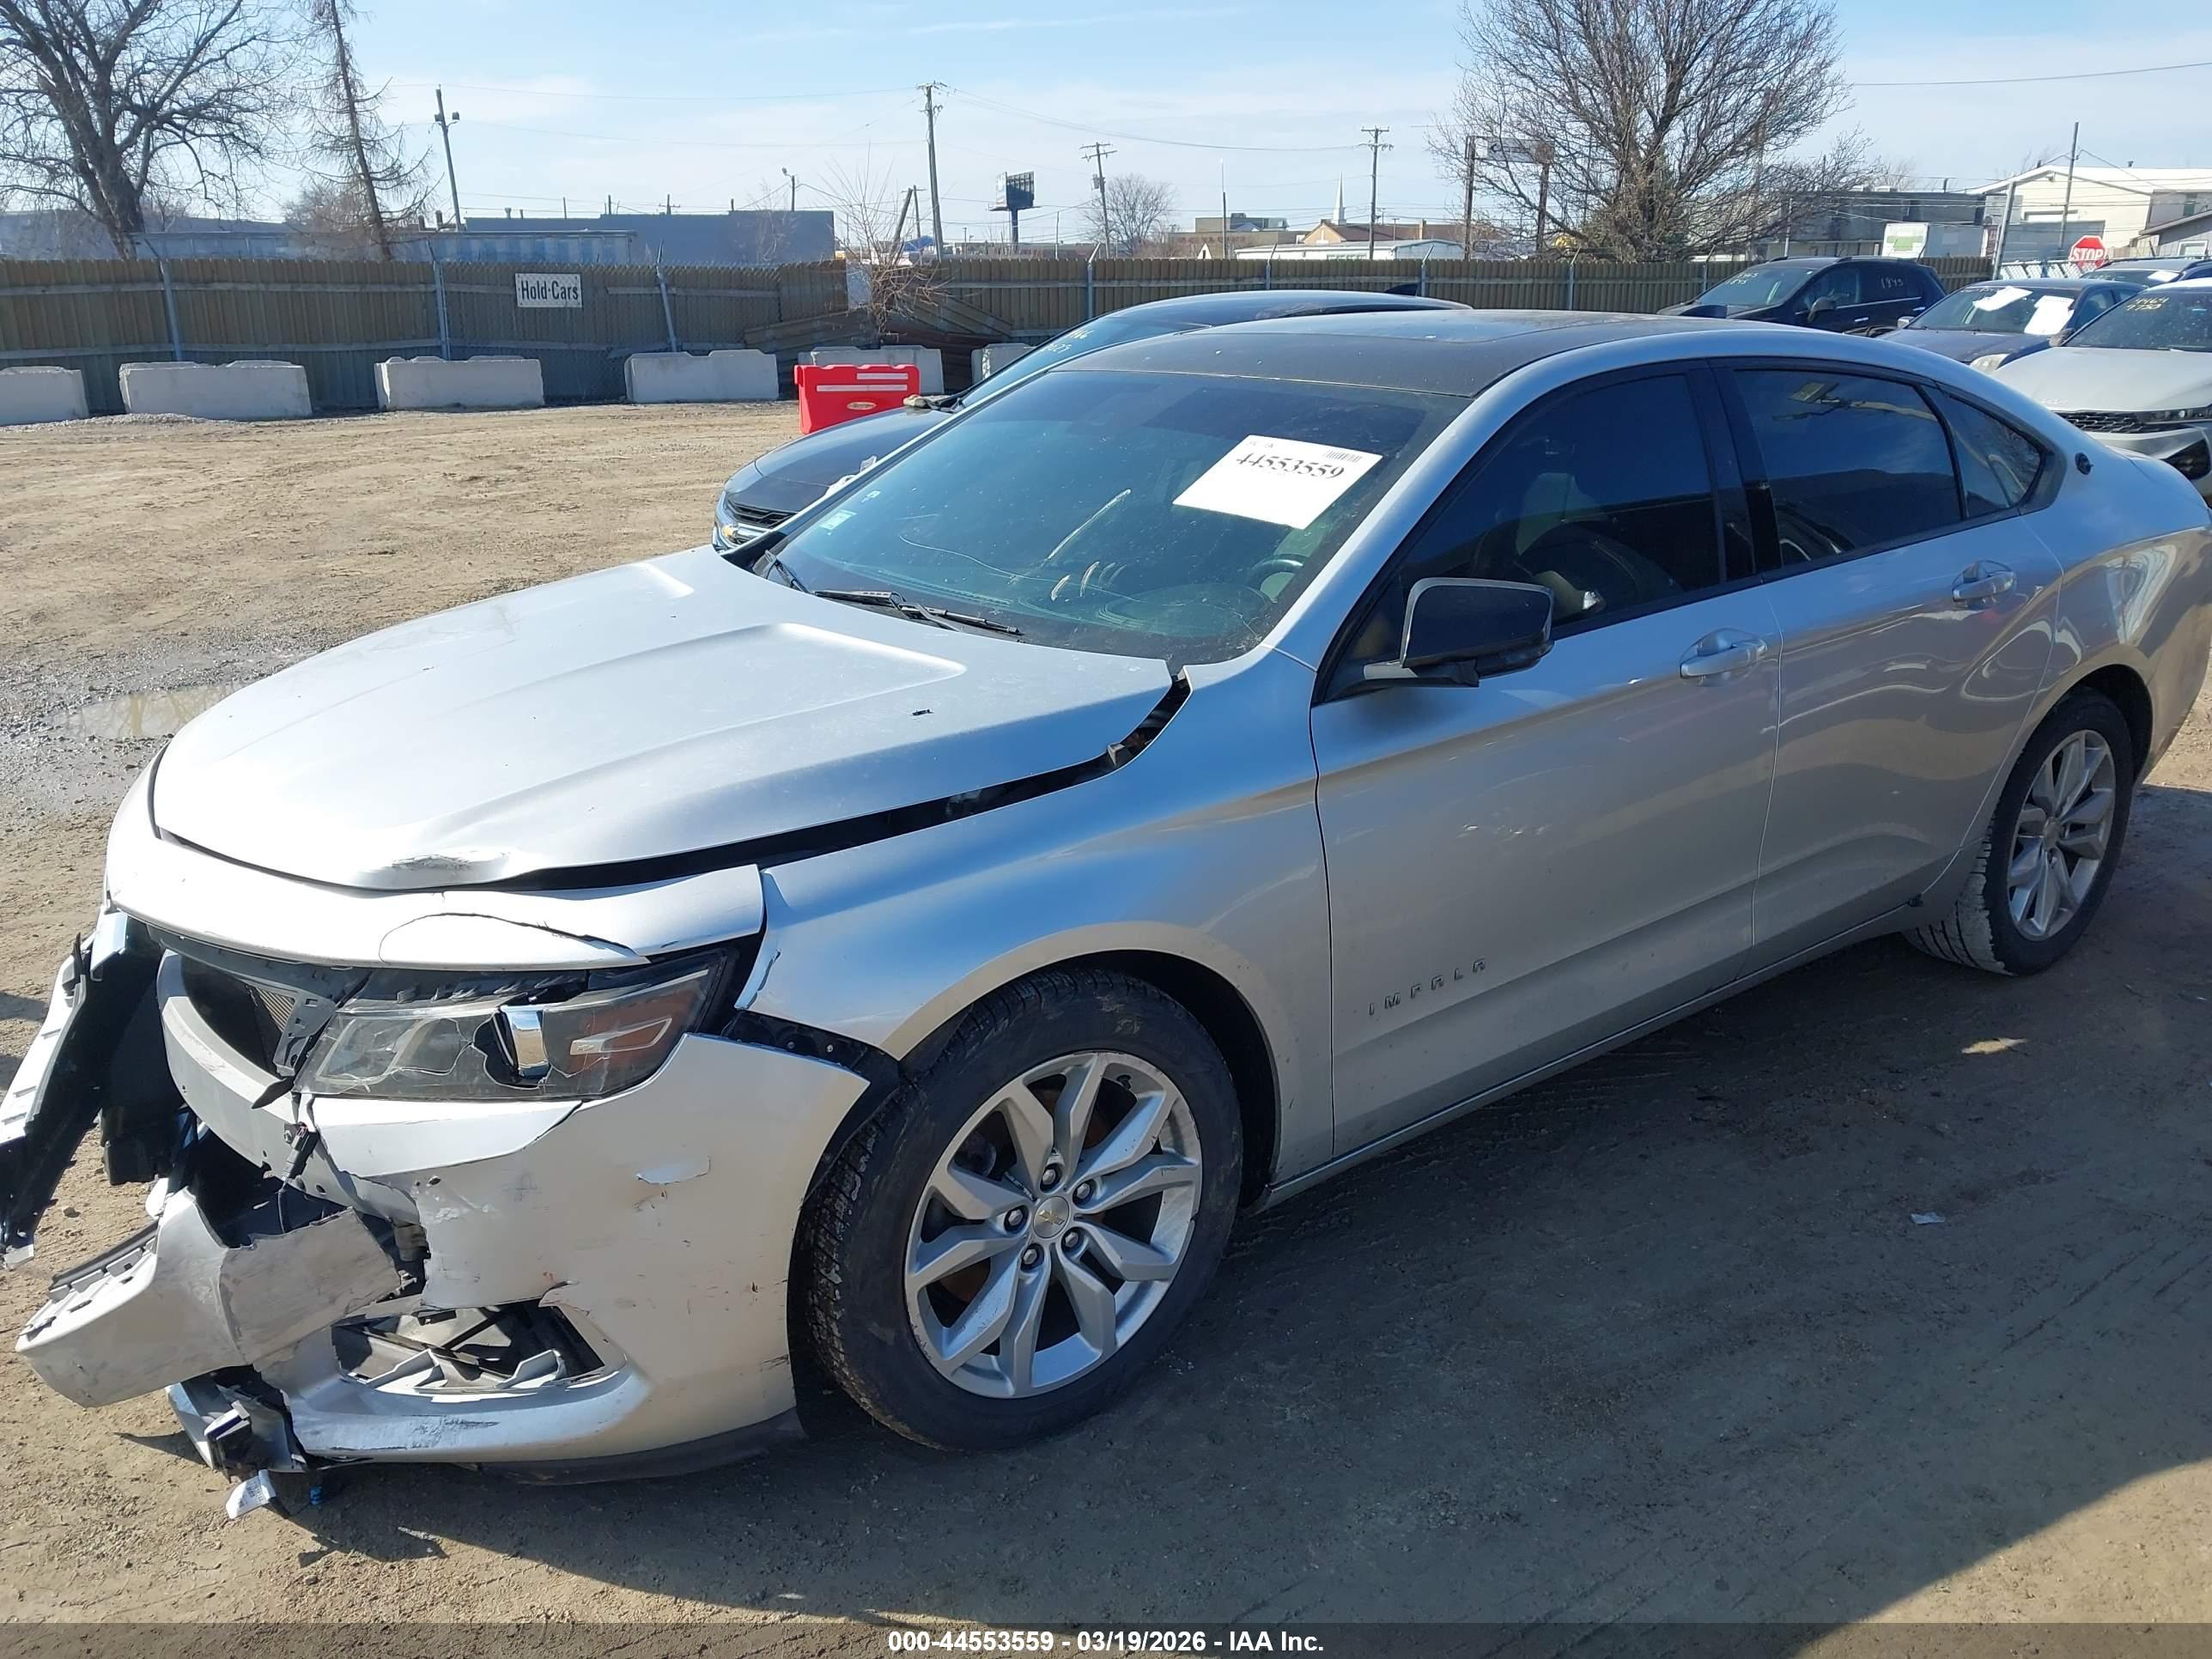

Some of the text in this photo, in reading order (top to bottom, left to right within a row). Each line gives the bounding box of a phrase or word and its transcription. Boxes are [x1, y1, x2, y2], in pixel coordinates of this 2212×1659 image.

[2070, 247, 2104, 261] STOP
[520, 280, 579, 301] Hold Cars
[1237, 453, 1346, 478] 44553559
[1368, 957, 1486, 1016] IMPALA
